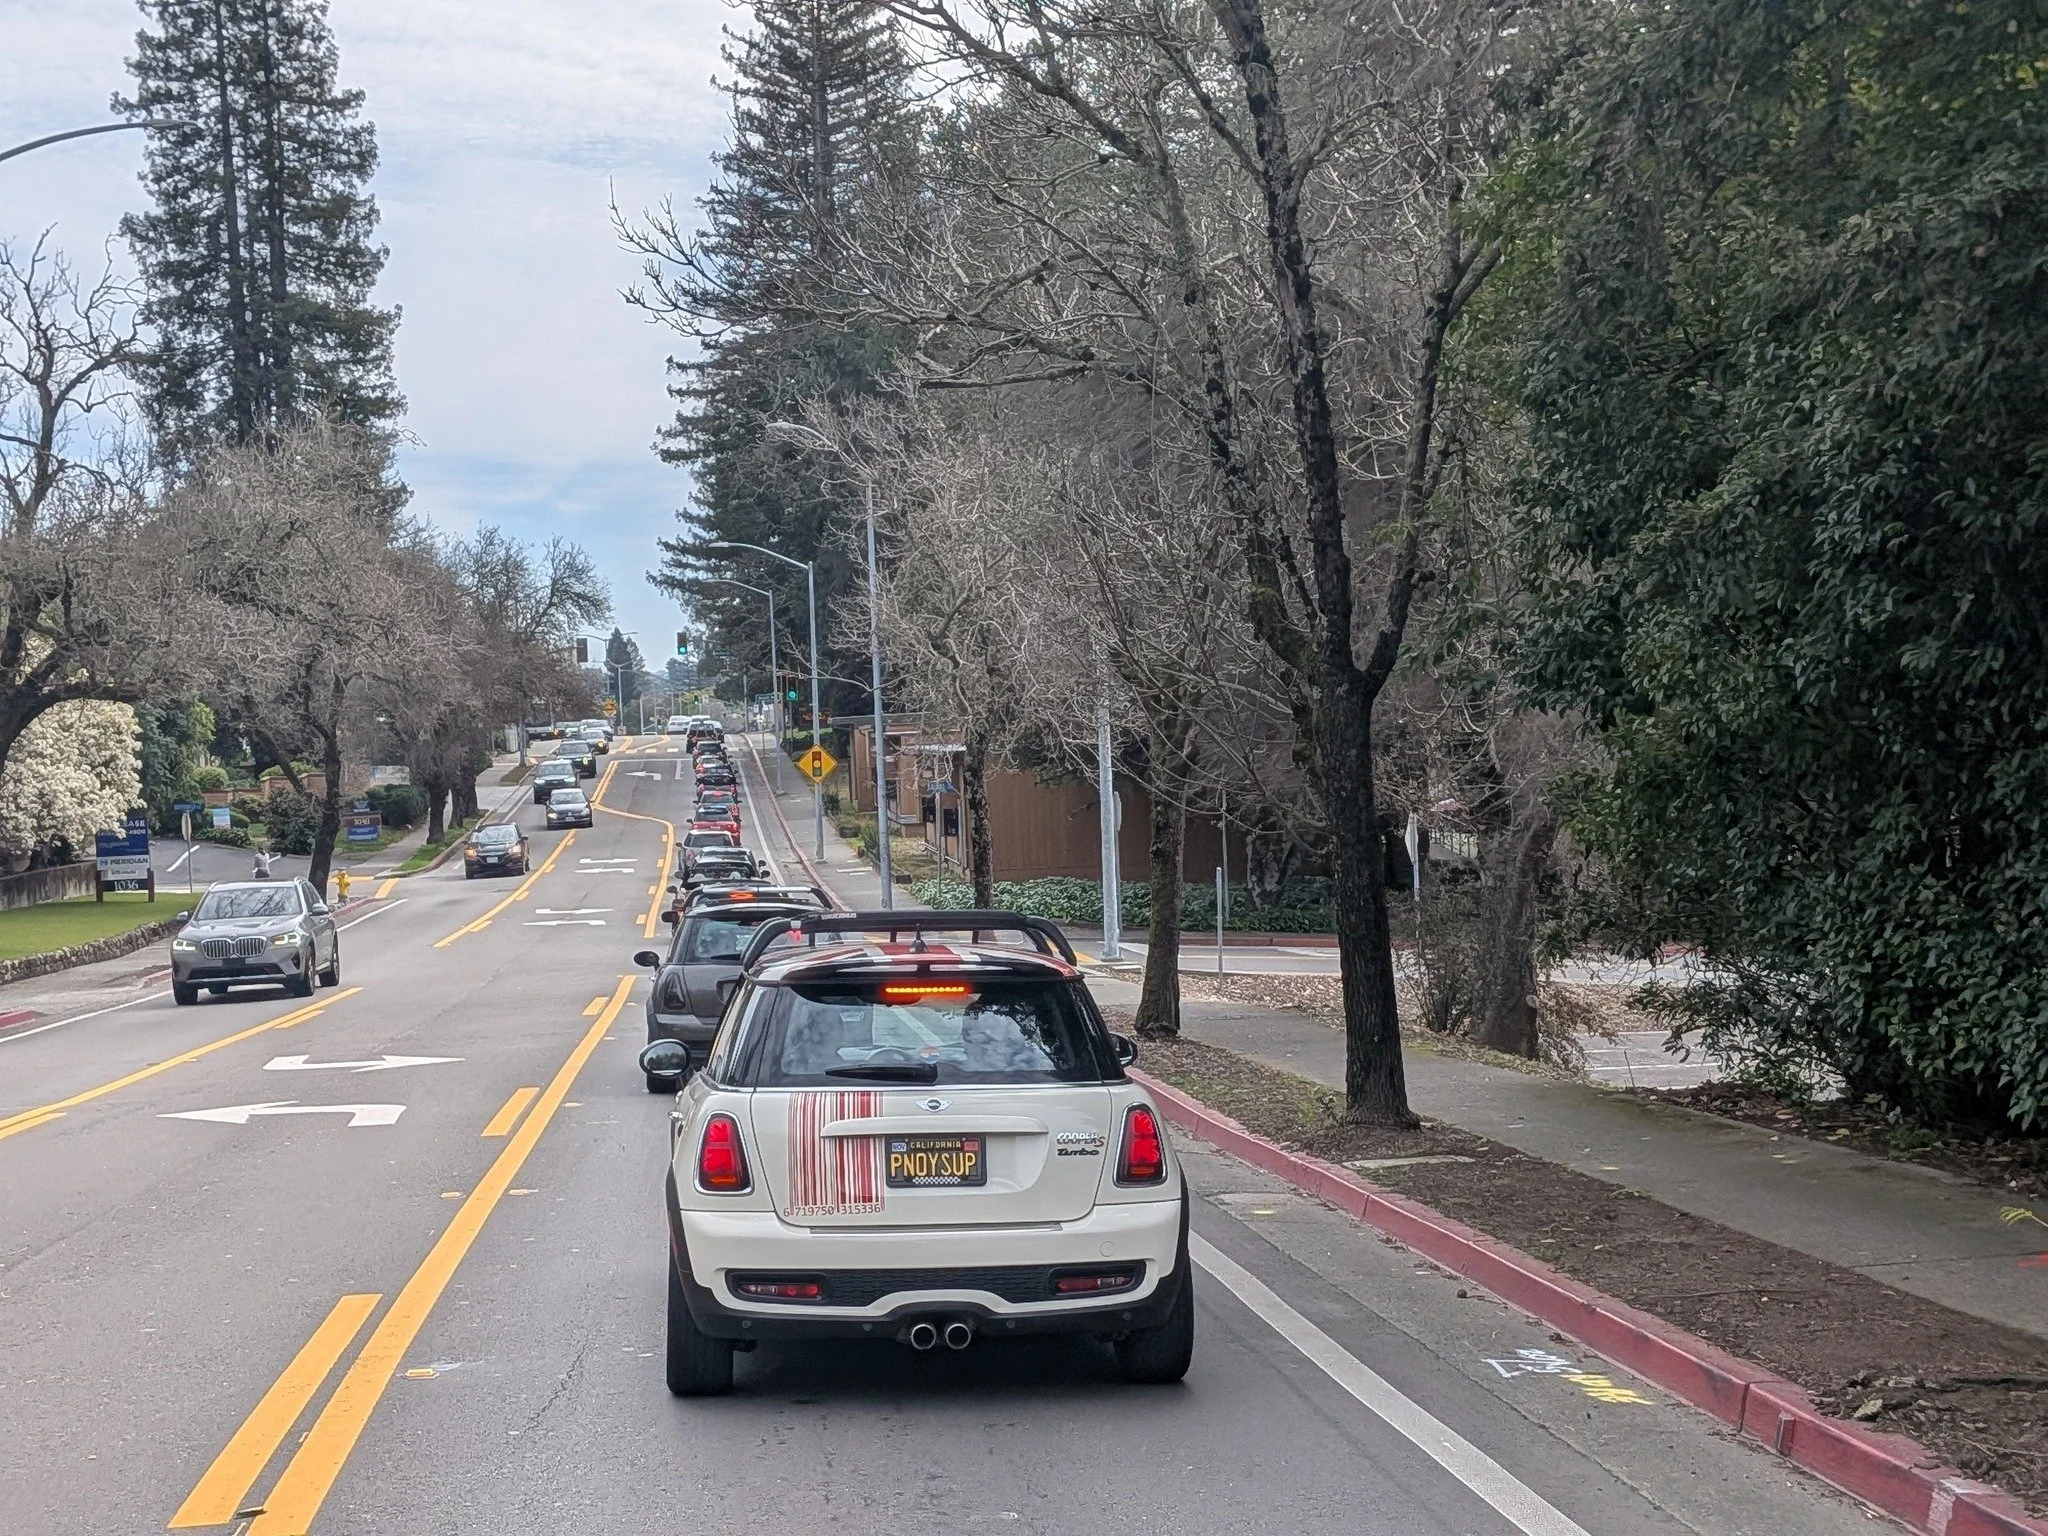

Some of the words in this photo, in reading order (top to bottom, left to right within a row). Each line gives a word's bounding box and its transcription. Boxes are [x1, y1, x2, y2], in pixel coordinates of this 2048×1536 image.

[110, 857, 149, 865] MERIDIAN
[114, 879, 139, 891] 1036
[909, 1140, 961, 1149] CALIFORNIA
[1056, 1132, 1098, 1145] COOPER
[1056, 1147, 1100, 1157] Turbo
[890, 1152, 976, 1177] PNOYSUP
[783, 1207, 790, 1217] 6
[795, 1205, 835, 1217] 719750
[841, 1203, 881, 1215] 315336
